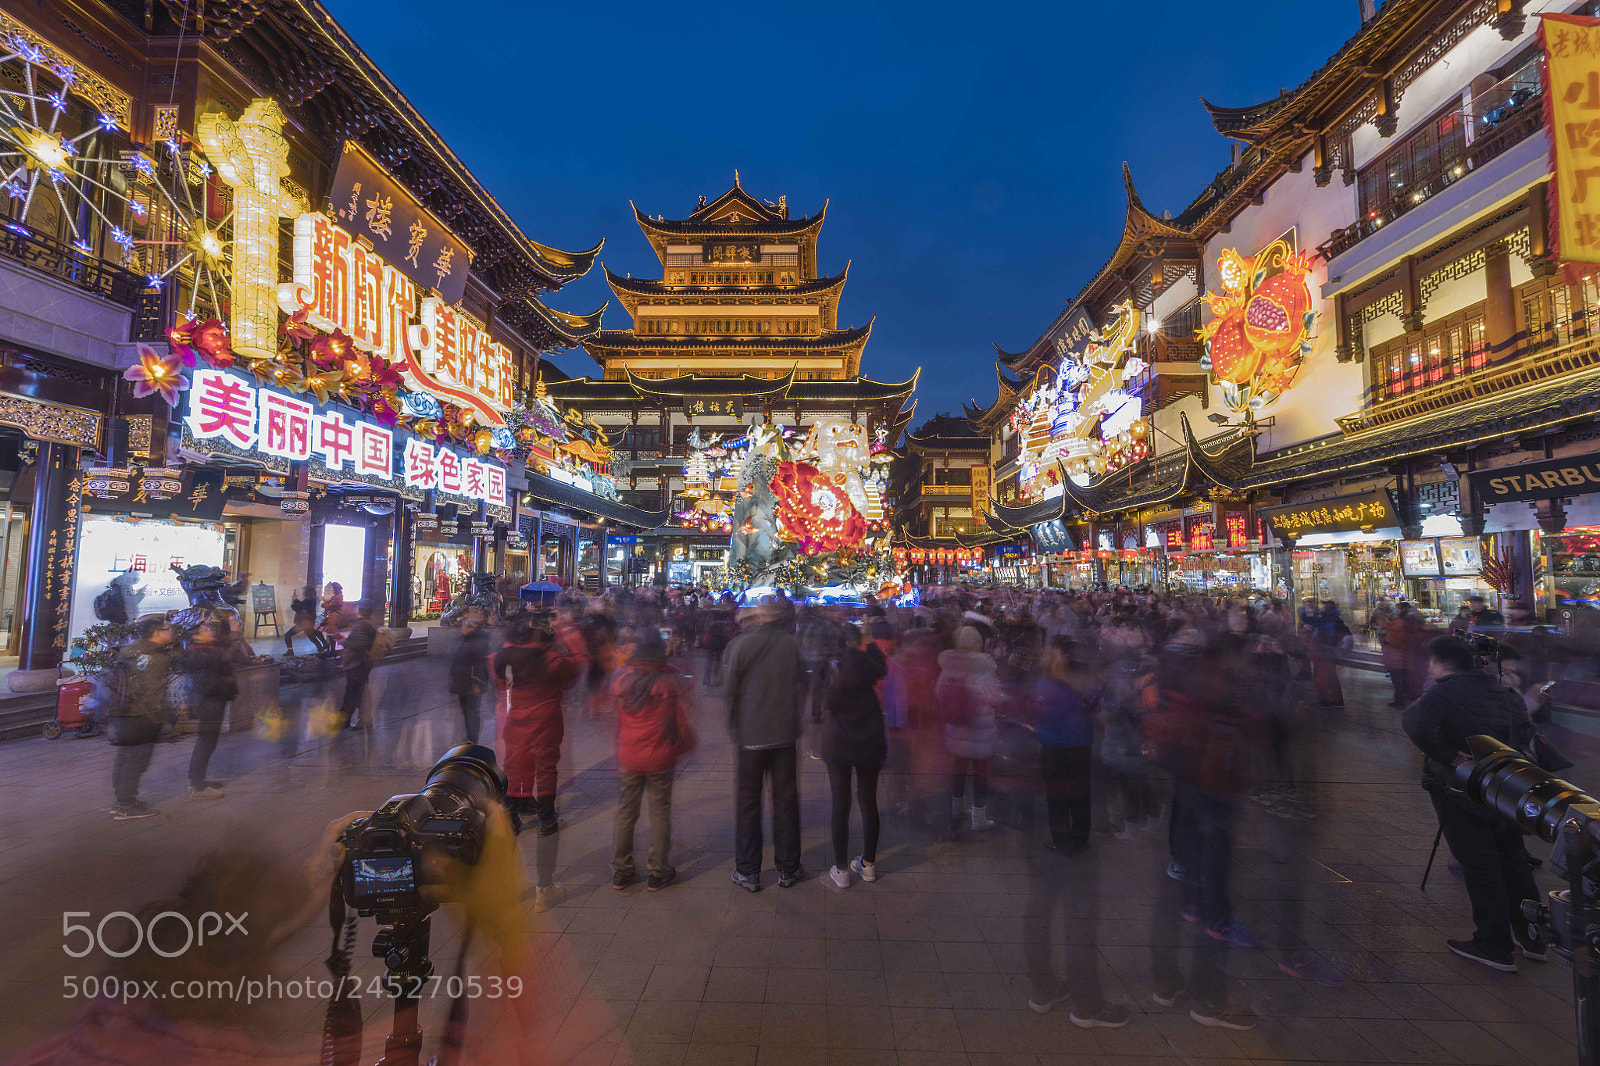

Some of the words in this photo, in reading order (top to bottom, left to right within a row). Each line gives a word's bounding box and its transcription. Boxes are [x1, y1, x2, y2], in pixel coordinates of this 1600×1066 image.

[312, 217, 416, 360] 新时代
[434, 299, 514, 410] 美好生活
[197, 373, 392, 478] 美丽中国
[407, 440, 506, 503] 绿色家园
